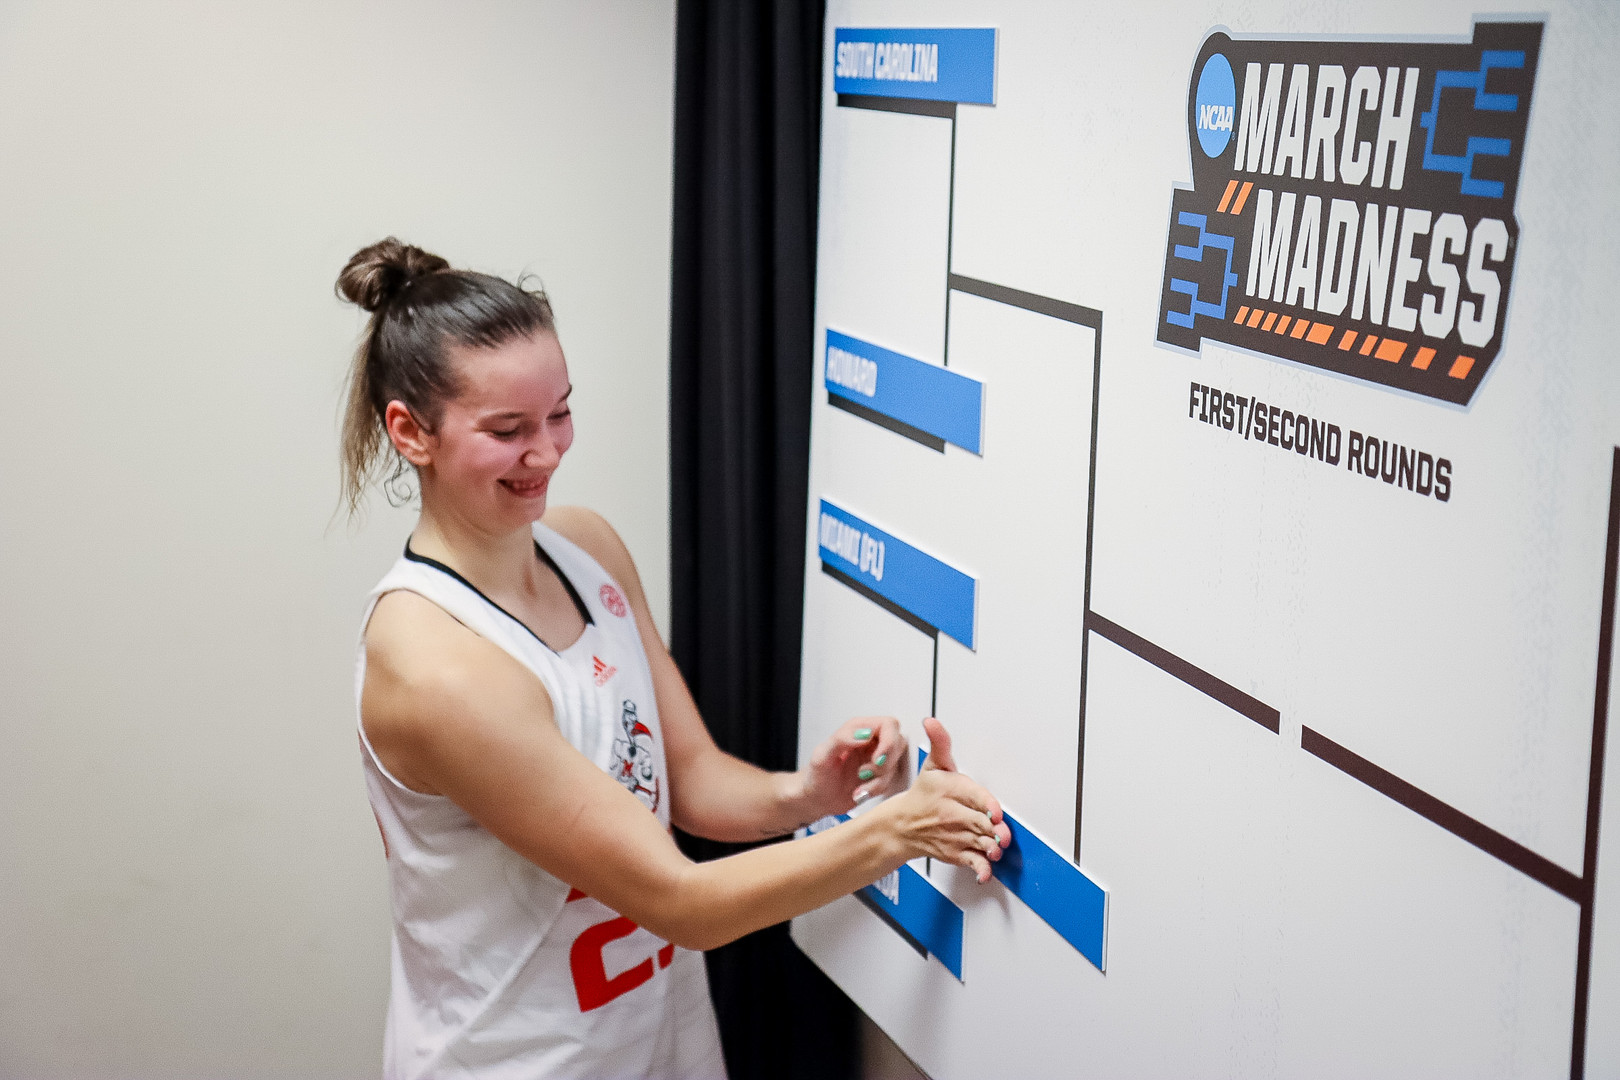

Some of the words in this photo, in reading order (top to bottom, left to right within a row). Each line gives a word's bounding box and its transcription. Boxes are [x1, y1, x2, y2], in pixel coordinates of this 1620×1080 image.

[836, 42, 874, 79] SOUTH
[875, 42, 938, 83] CAROLINA
[1198, 103, 1234, 132] NCAA
[1234, 63, 1420, 190] MARCH
[1245, 189, 1510, 348] MADNESS
[1188, 381, 1342, 466] FIRST/SECOND
[1347, 430, 1452, 503] ROUNDS
